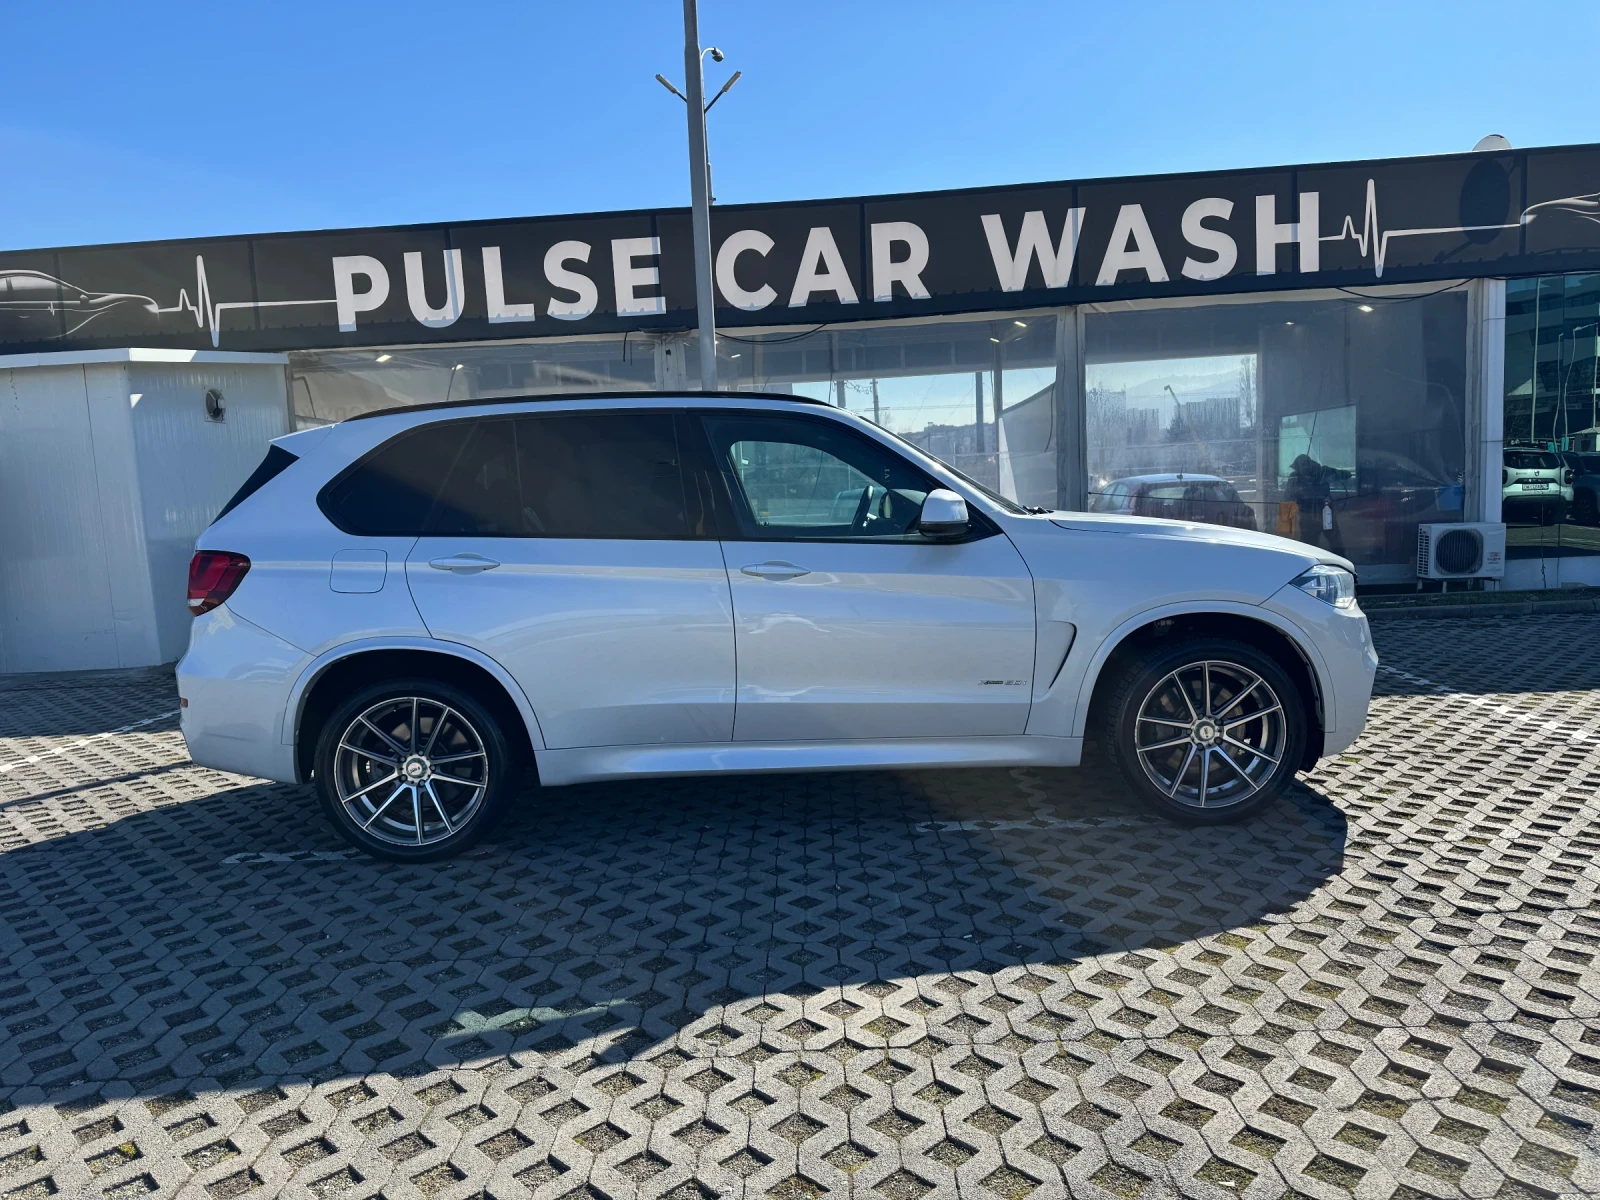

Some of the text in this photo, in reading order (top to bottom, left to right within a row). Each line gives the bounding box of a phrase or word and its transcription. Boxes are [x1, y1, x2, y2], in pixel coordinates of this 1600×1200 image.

[332, 191, 1321, 332] PULSE CAR WASH
